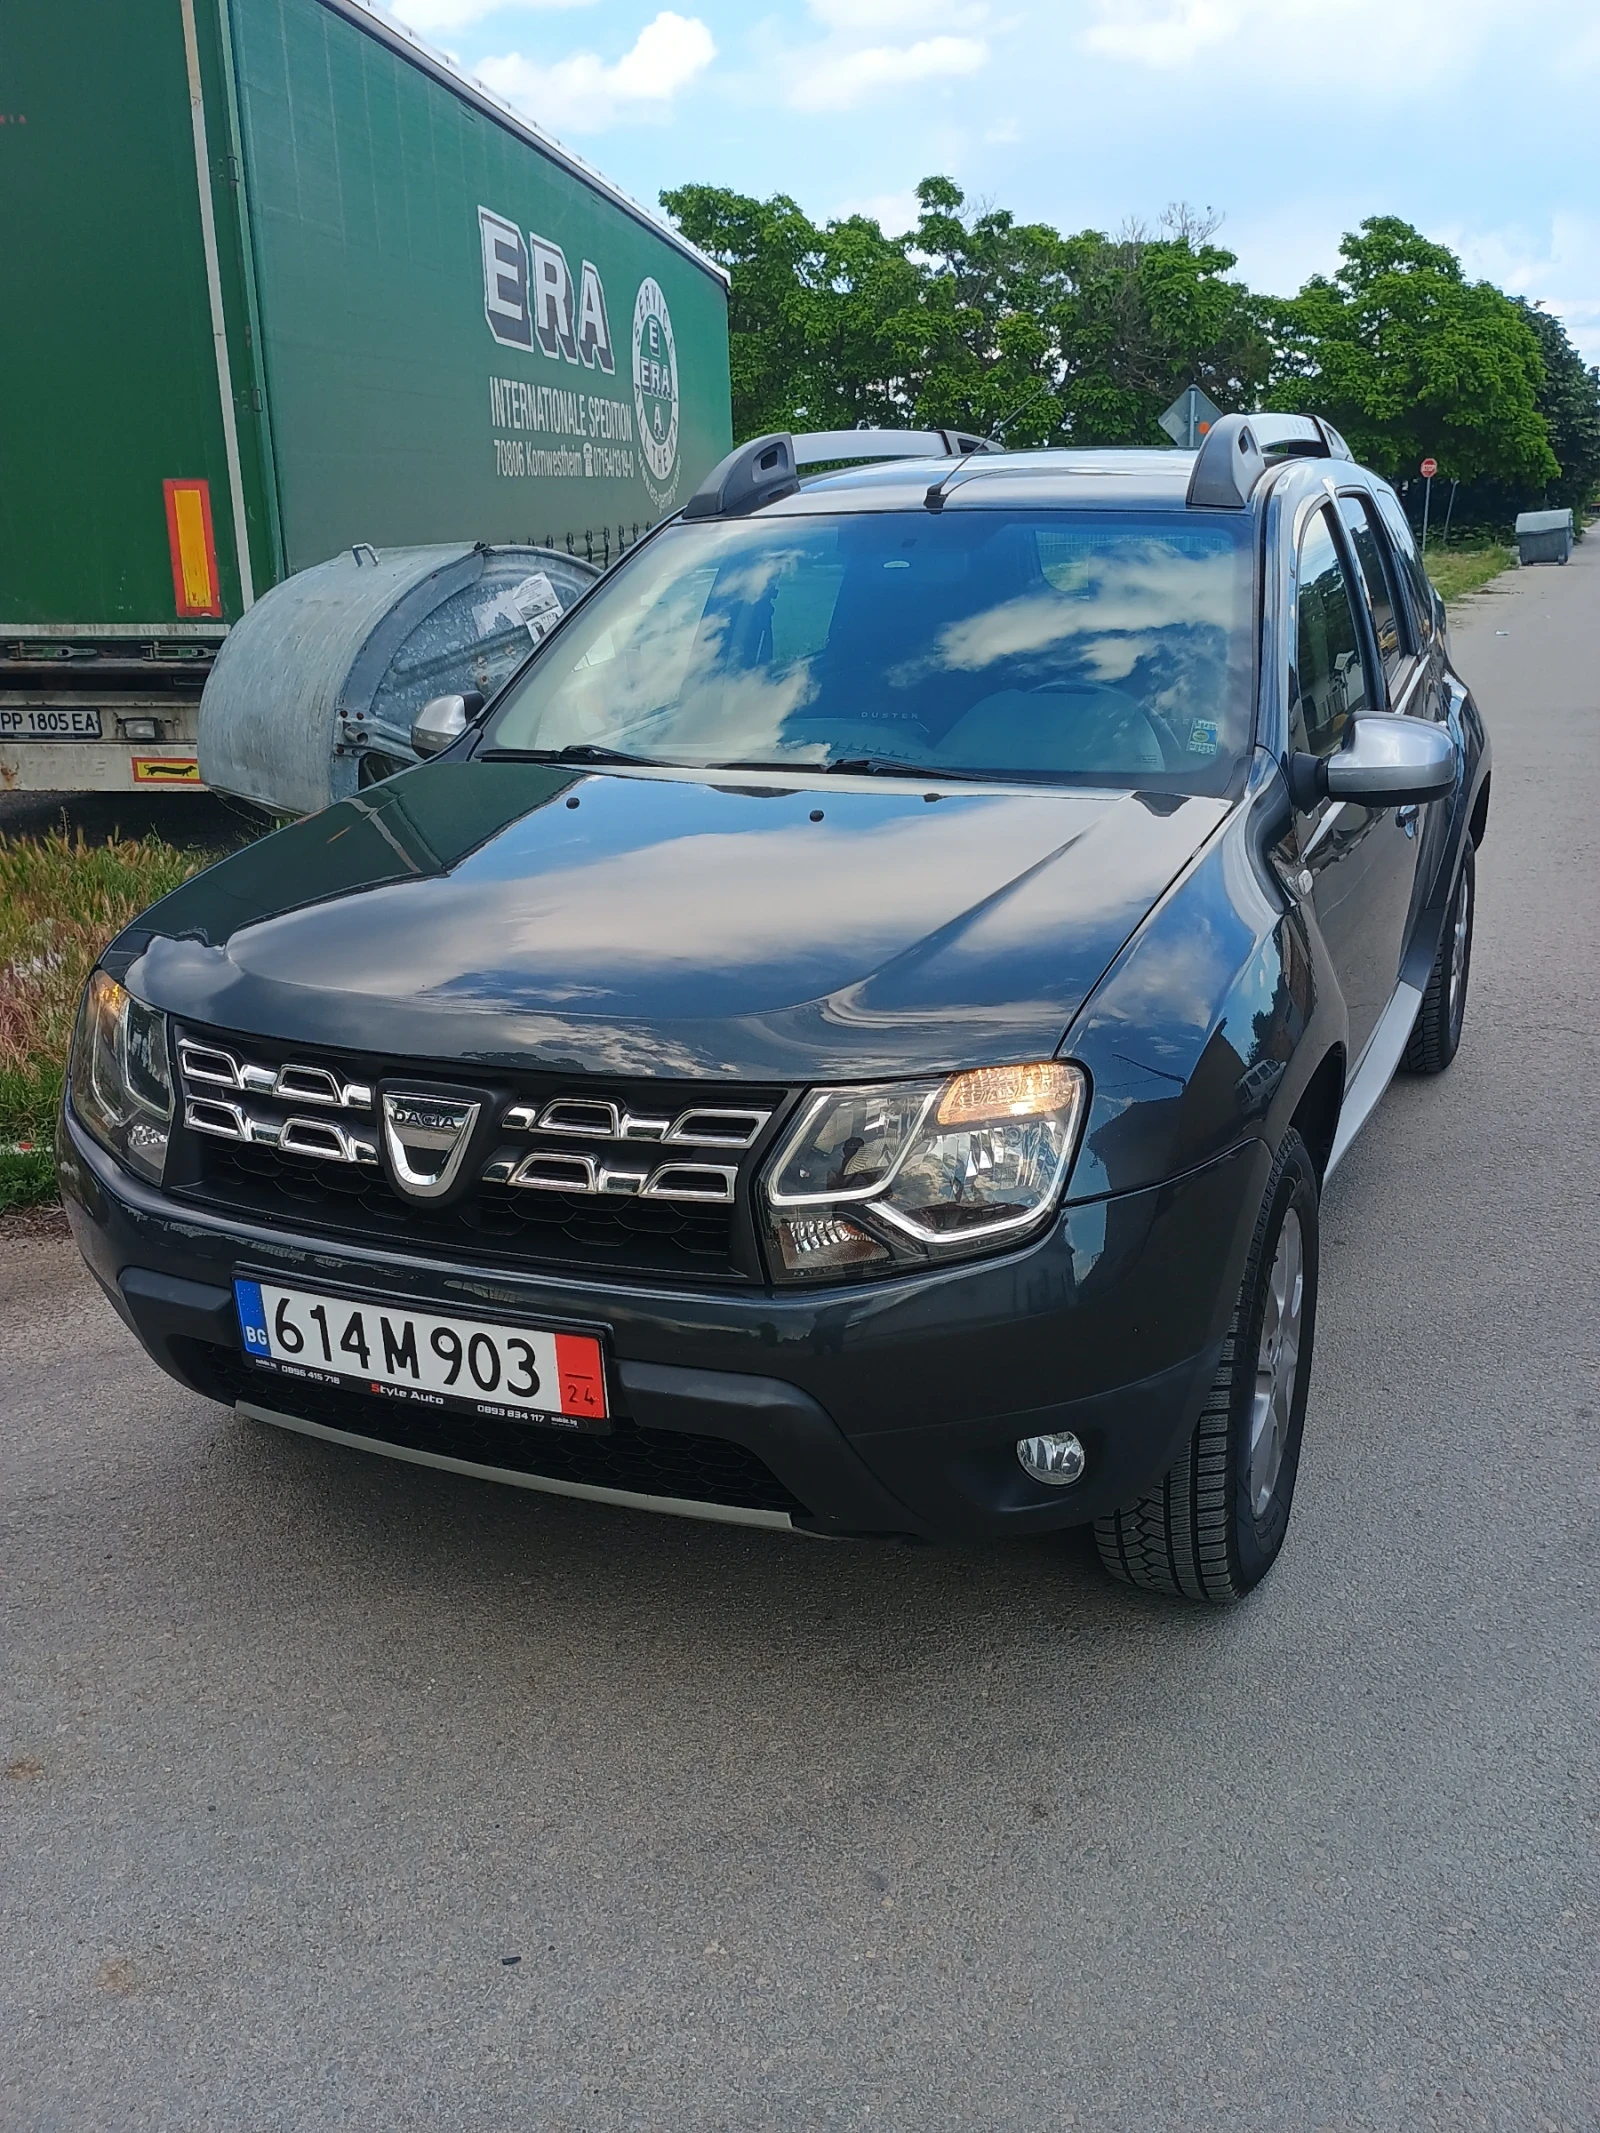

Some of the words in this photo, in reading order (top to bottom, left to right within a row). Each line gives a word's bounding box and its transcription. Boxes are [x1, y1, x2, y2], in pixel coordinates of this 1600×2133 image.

[478, 205, 615, 375] ERA
[639, 355, 675, 402] ERA
[489, 376, 587, 436] INTERNATIONALE
[588, 396, 633, 442] SPEDITION
[493, 439, 525, 477] 70806
[525, 441, 583, 477] Kornwestheim
[652, 443, 669, 476] THE
[0, 712, 23, 731] PP
[28, 712, 69, 732] 1805
[72, 713, 96, 731] EA
[861, 711, 919, 720] DUSTER
[393, 1109, 458, 1129] DACIA
[245, 1325, 267, 1346] BG
[274, 1297, 540, 1398] 614M903
[307, 1371, 323, 1381] 415
[323, 1374, 341, 1384] 718
[371, 1383, 407, 1397] Style
[410, 1390, 444, 1405] Auto
[566, 1384, 597, 1406] 24
[477, 1404, 505, 1416] 0893
[507, 1410, 528, 1420] 834
[530, 1413, 545, 1422] 117
